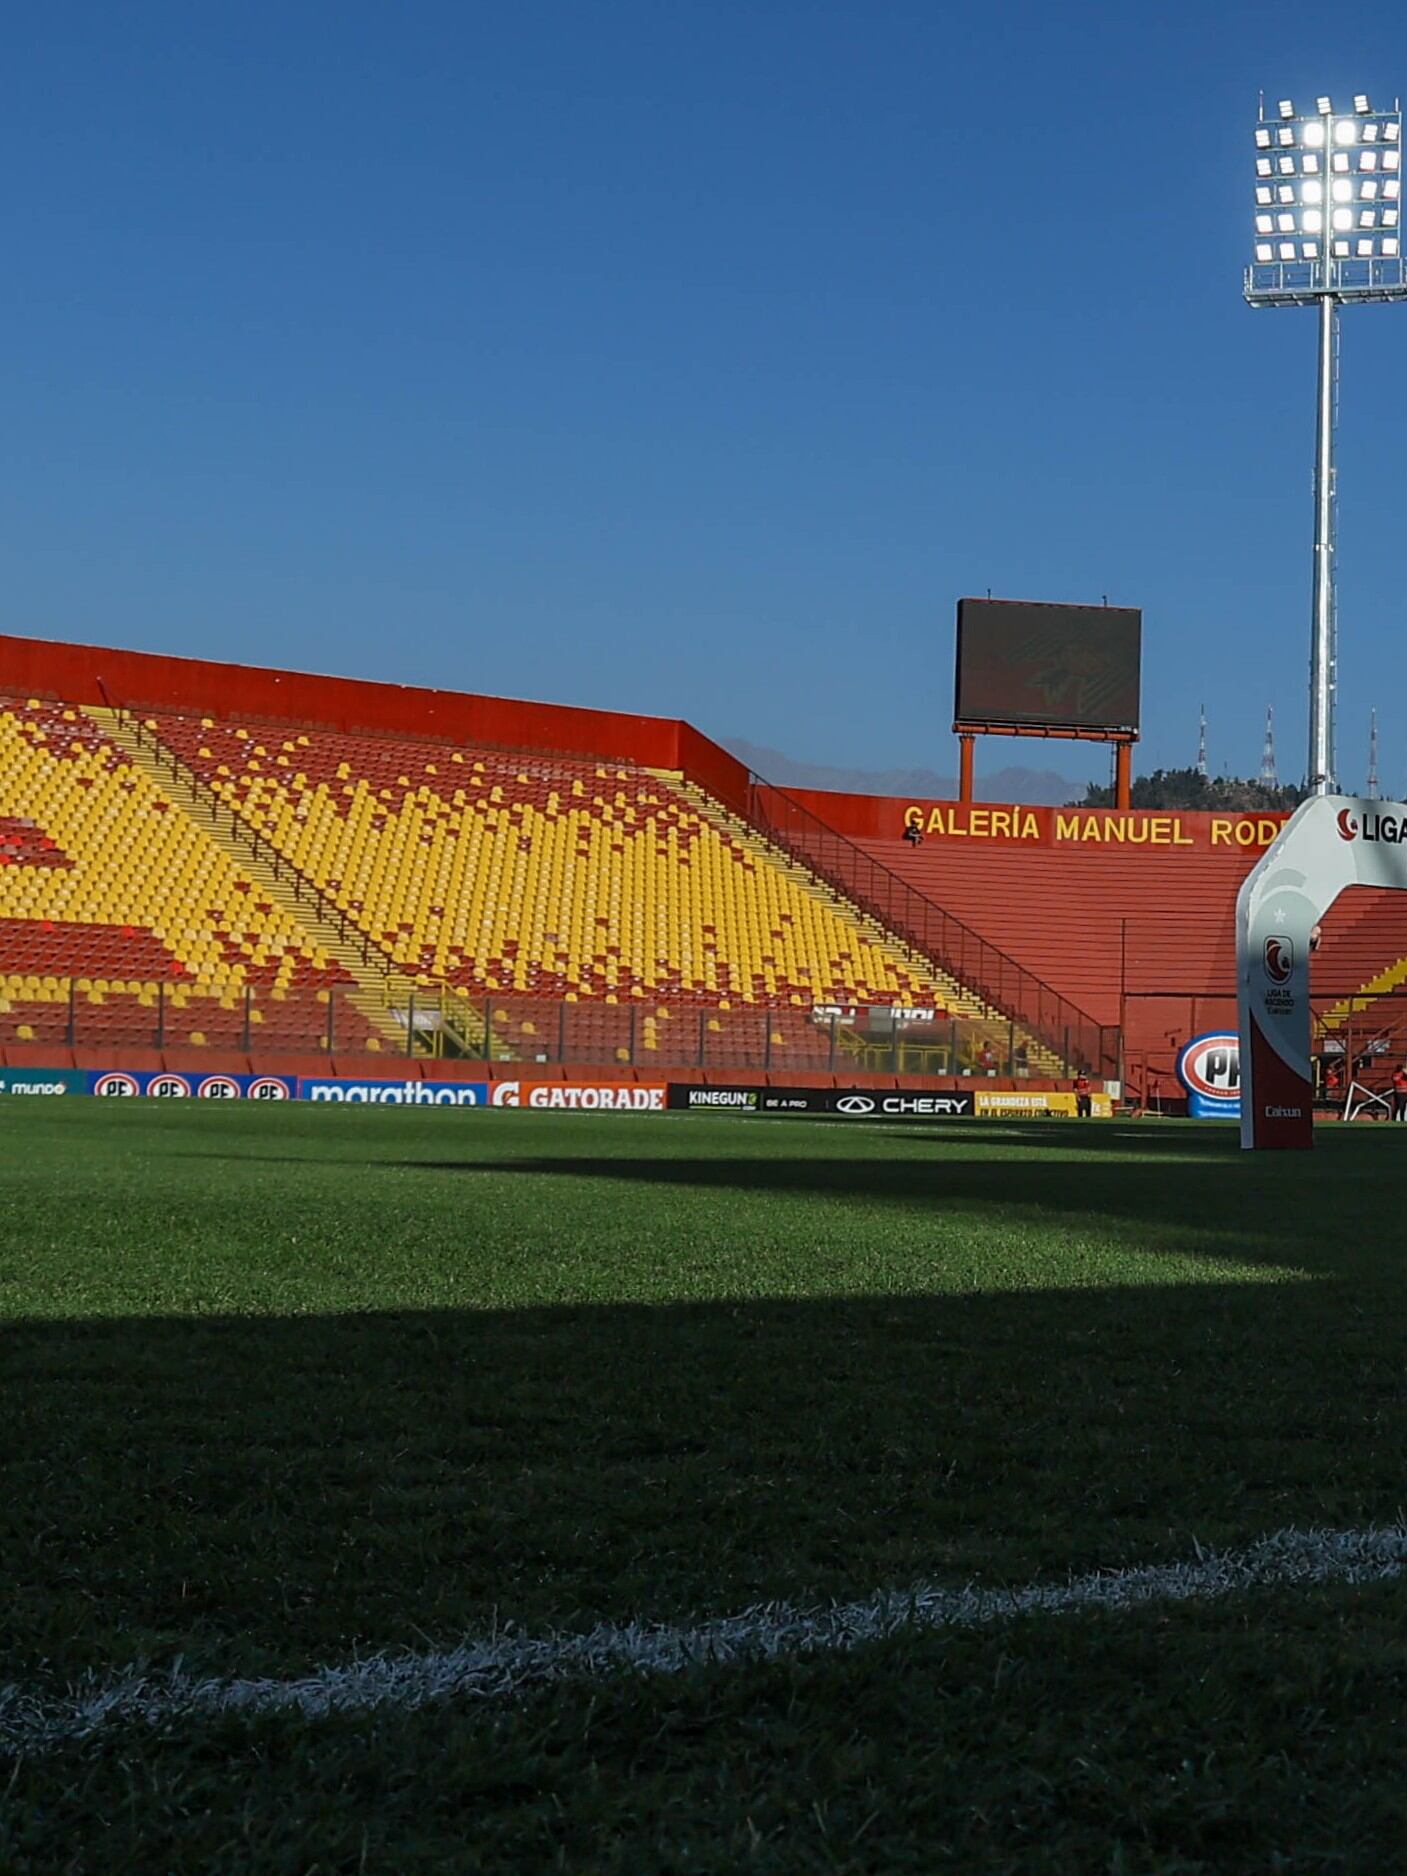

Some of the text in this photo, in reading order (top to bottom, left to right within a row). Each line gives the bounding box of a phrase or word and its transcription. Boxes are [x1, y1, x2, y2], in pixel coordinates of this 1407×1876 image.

[904, 805, 1040, 839] GALERÍA
[1056, 815, 1194, 845] MANUEL
[311, 1081, 476, 1106] marathon
[529, 1086, 663, 1110] GATORADE
[689, 1091, 748, 1105] KINEGUN
[766, 1099, 807, 1109] BE A PRO
[882, 1098, 968, 1114] CHERY
[1265, 1105, 1301, 1118] Caixun
